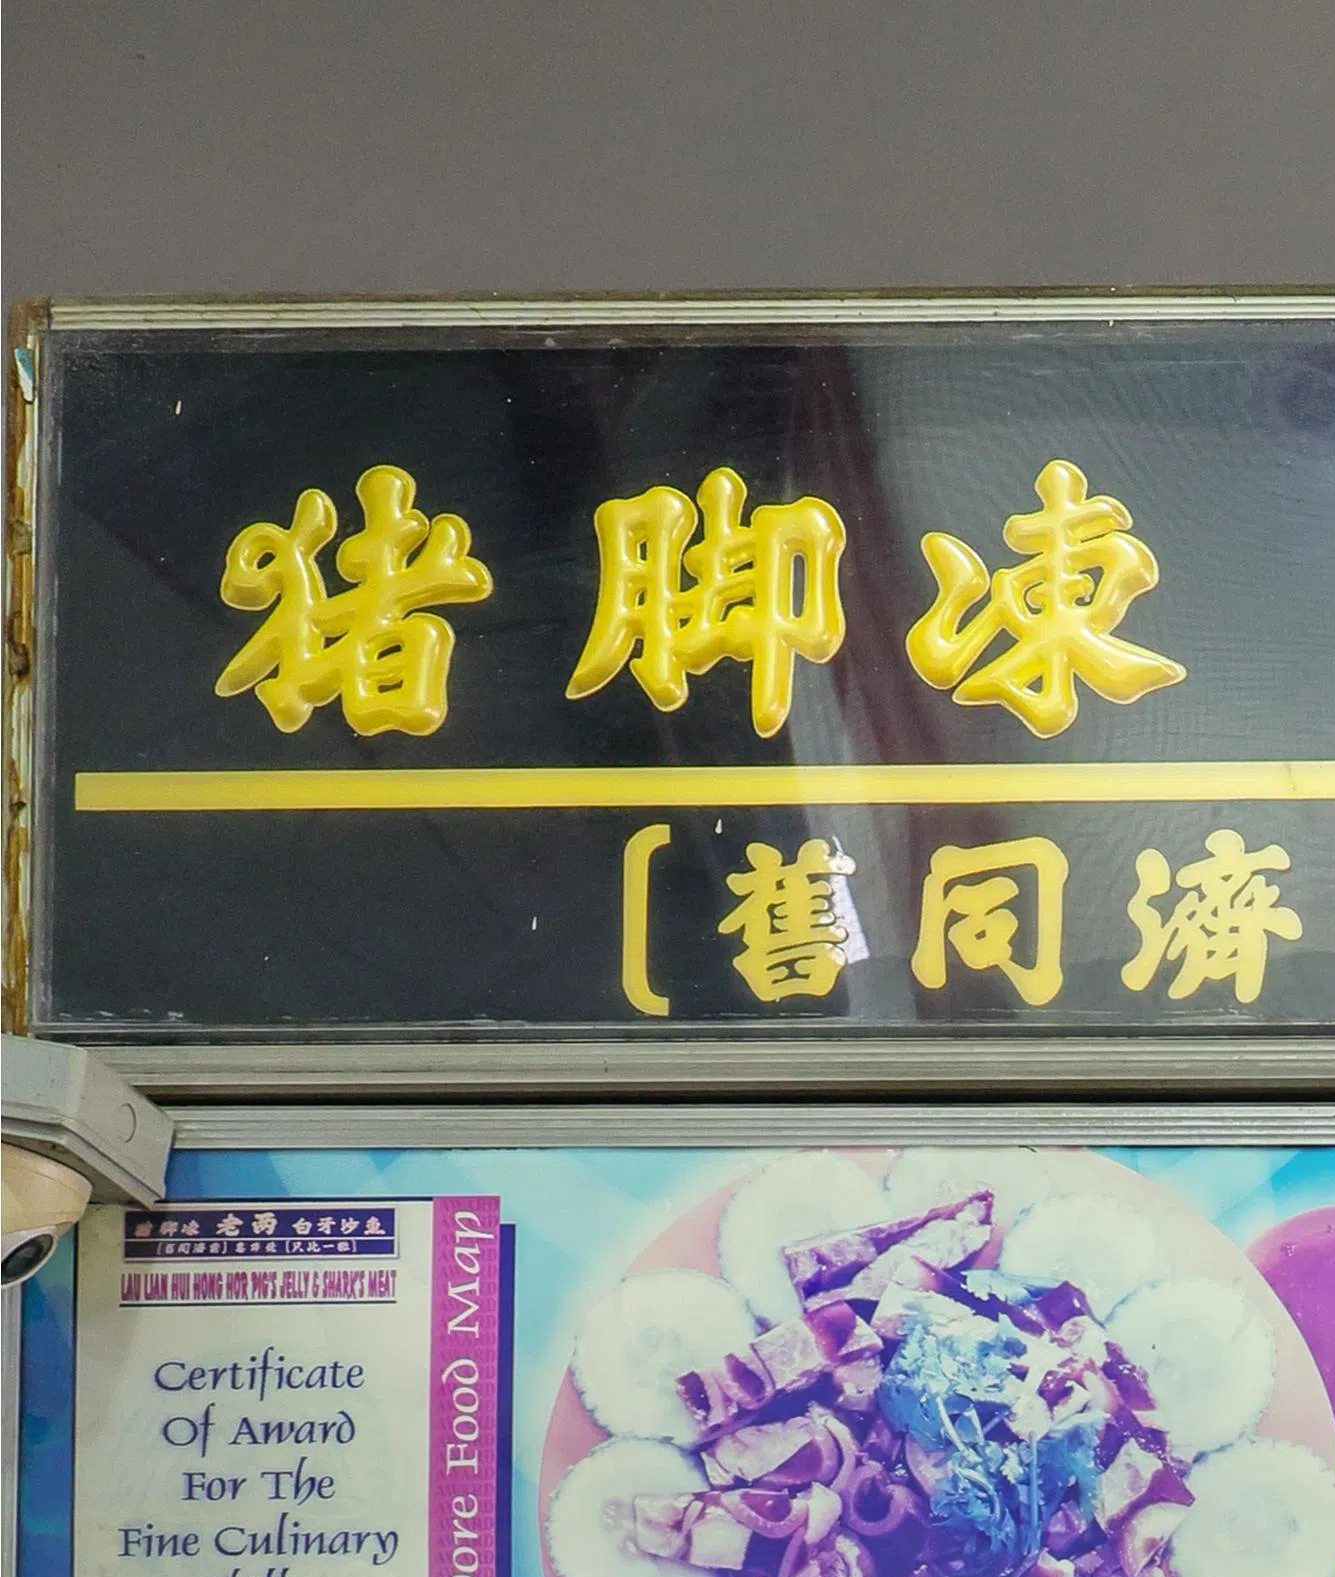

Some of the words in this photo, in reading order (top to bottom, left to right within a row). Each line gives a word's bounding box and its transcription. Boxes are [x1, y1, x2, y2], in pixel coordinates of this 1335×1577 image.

[121, 1273, 141, 1301] LAU
[144, 1273, 168, 1301] LIAN
[171, 1273, 190, 1301] HUI
[193, 1273, 222, 1301] HONG
[226, 1272, 248, 1301] HOR
[279, 1272, 310, 1300] JELLY
[321, 1271, 365, 1300] SHARK'S
[367, 1271, 397, 1300] MEAT
[447, 1208, 483, 1337] Map
[153, 1347, 366, 1402] Certificate
[162, 1404, 216, 1457] Of
[229, 1410, 357, 1448] Award
[445, 1358, 480, 1476] Food
[182, 1471, 247, 1502] For
[261, 1458, 335, 1505] The
[117, 1521, 201, 1559] Fine
[213, 1512, 400, 1567] Culinary
